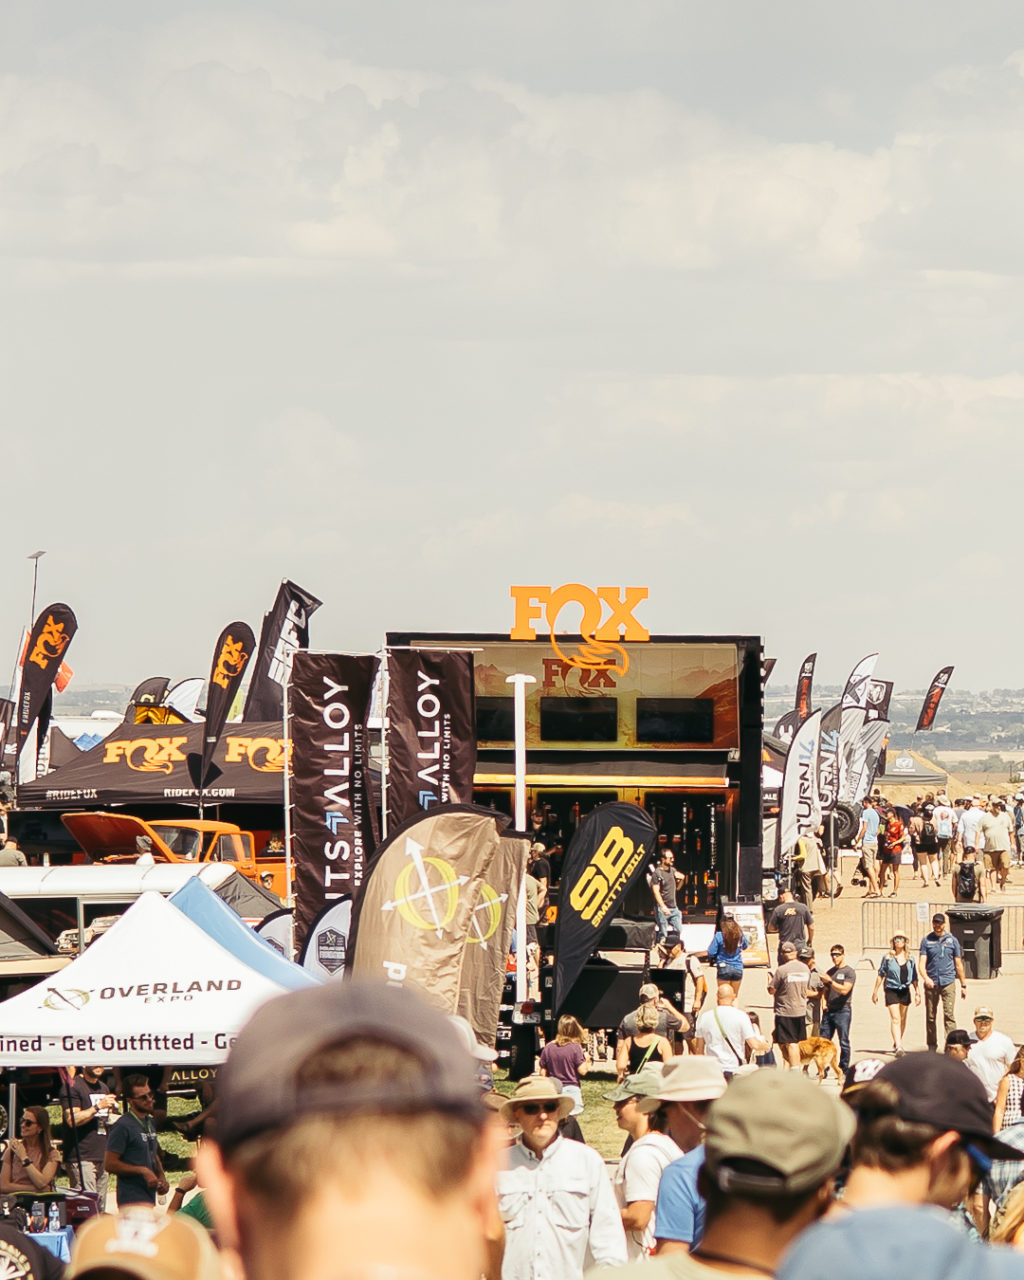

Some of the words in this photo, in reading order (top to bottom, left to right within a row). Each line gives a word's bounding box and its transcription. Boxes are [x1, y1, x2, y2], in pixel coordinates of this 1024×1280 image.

[29, 615, 70, 669] FOX
[510, 583, 650, 677] FOX
[213, 635, 249, 689] FOX
[322, 676, 350, 809] ALLOY
[353, 723, 363, 767] LIMITS
[417, 670, 441, 787] ALLOY
[443, 713, 452, 750] LIMITS
[103, 737, 188, 774] FOX
[442, 753, 451, 772] NO
[353, 769, 363, 789] NO
[442, 774, 451, 803] WITH
[353, 792, 363, 827] WITH
[353, 830, 364, 887] EXPLORE
[569, 825, 635, 921] SB
[591, 843, 646, 929] SMITTYBILT
[99, 979, 242, 1001] OVERLAND
[144, 994, 193, 1004] EXPO
[62, 1036, 95, 1051] Get
[102, 1033, 194, 1051] Outfitted
[171, 1069, 219, 1081] ALLOY
